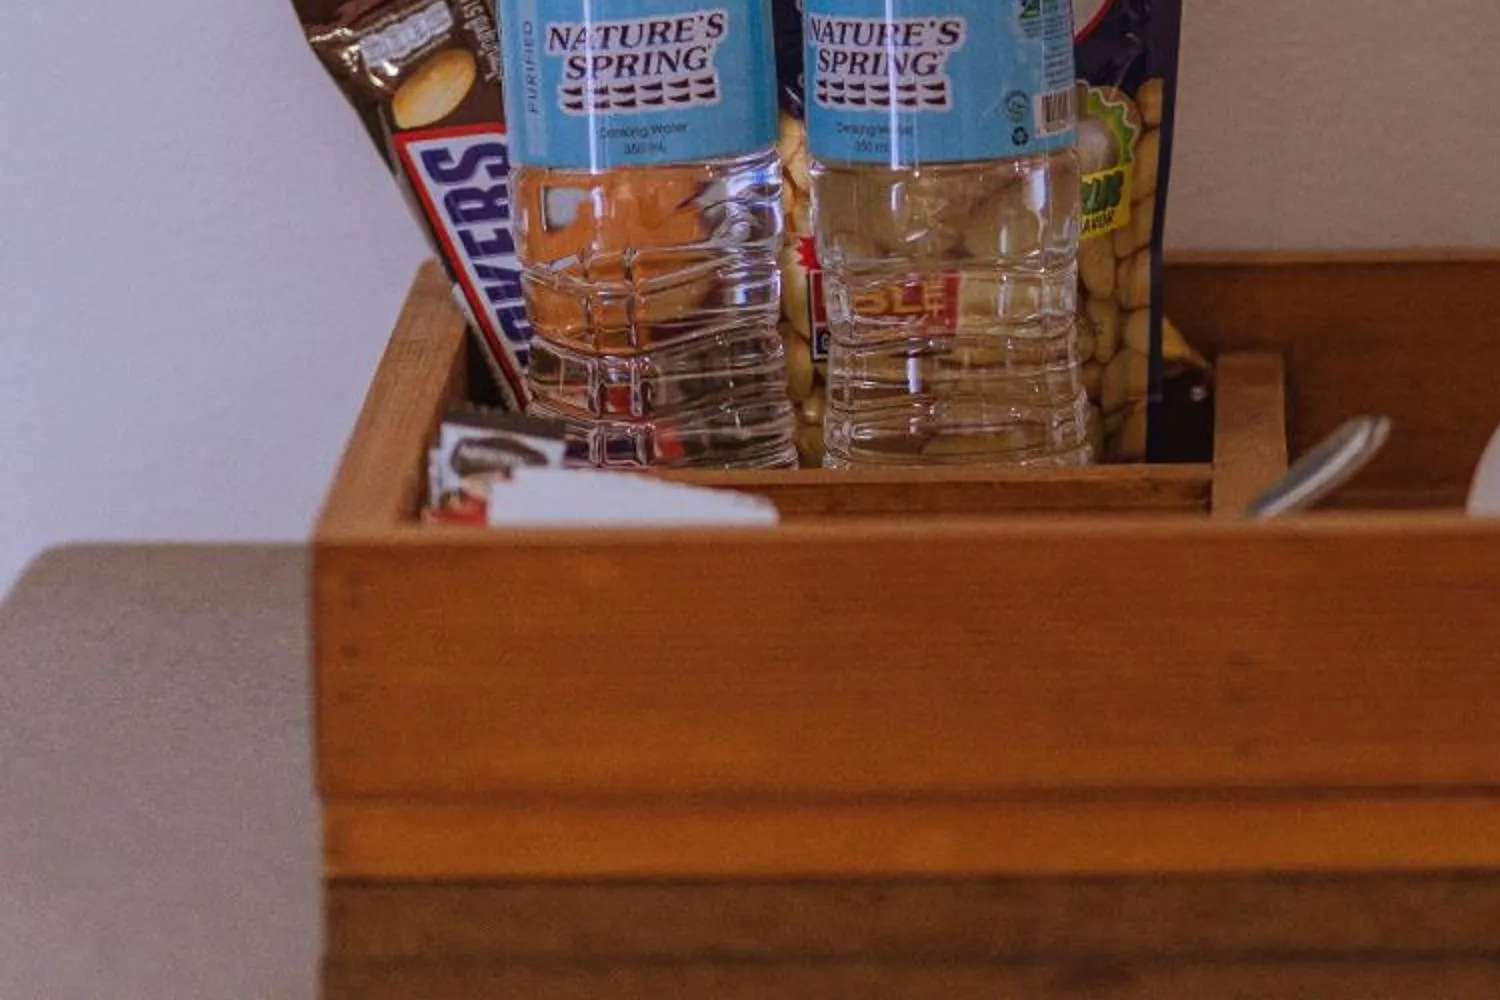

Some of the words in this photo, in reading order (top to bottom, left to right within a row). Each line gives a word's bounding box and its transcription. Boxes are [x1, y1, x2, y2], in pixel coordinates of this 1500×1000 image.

[549, 12, 725, 51] NATURE'S
[808, 18, 962, 47] NATURE'S
[522, 20, 539, 115] PURIFIED
[566, 47, 710, 80] SPRING
[817, 50, 941, 76] SPRING
[420, 142, 534, 367] KERS
